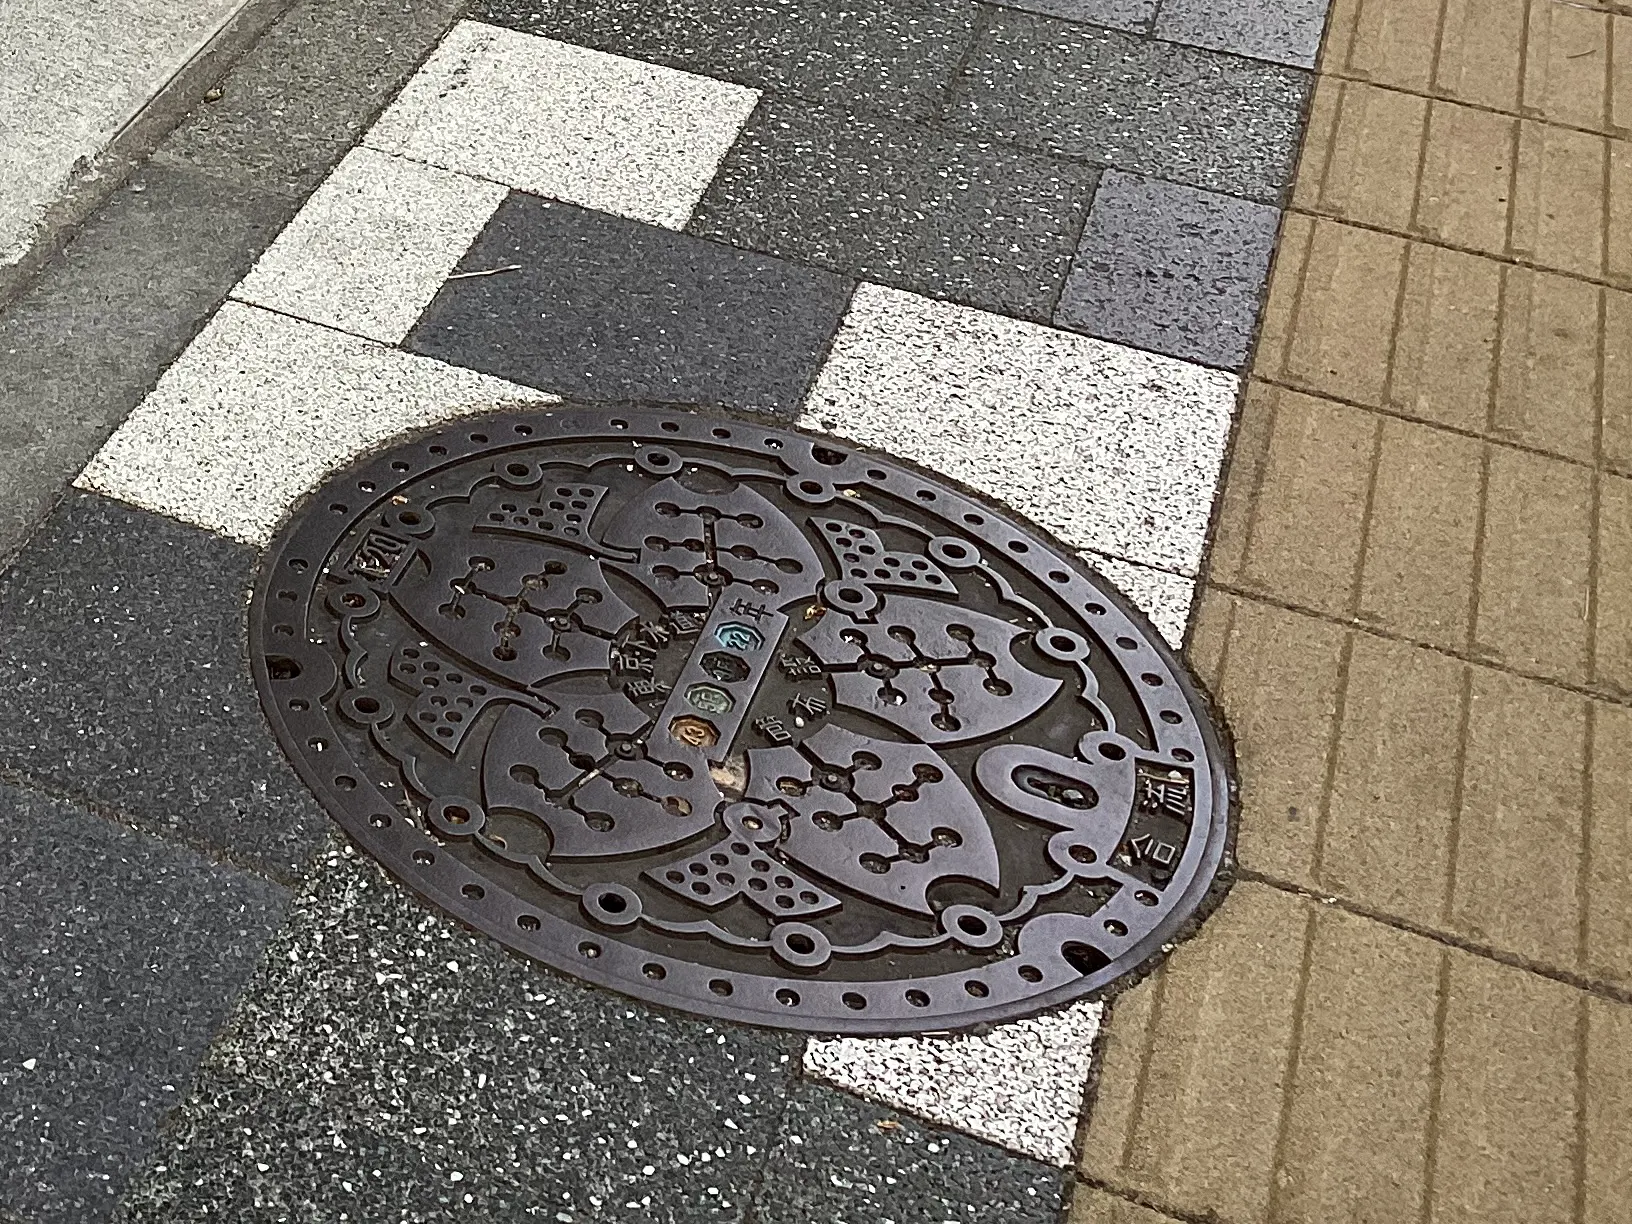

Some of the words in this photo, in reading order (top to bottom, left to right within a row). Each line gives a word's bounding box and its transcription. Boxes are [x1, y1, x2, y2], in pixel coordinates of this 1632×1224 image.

[729, 597, 774, 624] 年
[728, 631, 750, 649] 22
[681, 725, 705, 745] 43
[1130, 779, 1188, 864] 合流
